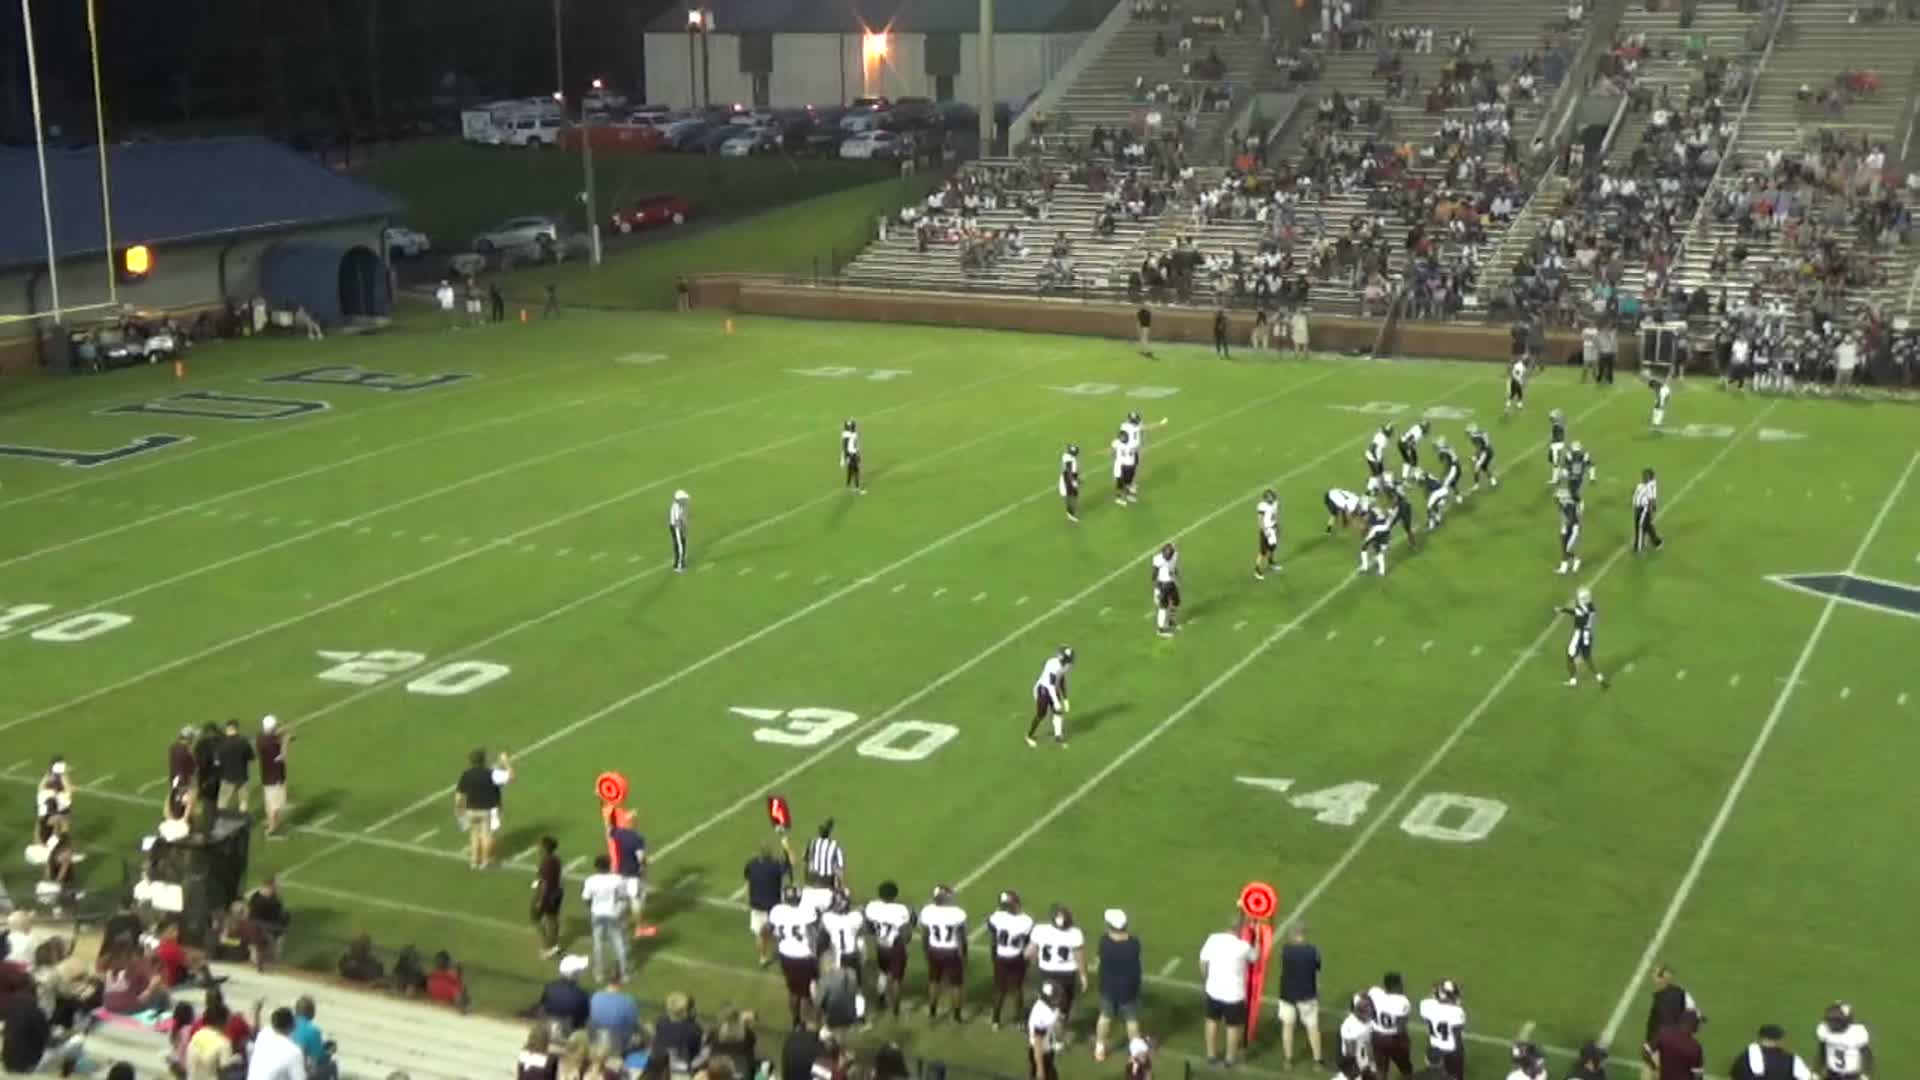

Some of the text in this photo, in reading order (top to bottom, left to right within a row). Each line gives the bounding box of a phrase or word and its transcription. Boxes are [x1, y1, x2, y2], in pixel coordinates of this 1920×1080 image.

[318, 649, 511, 695] 20
[753, 706, 960, 761] 30
[1286, 780, 1508, 842] 40
